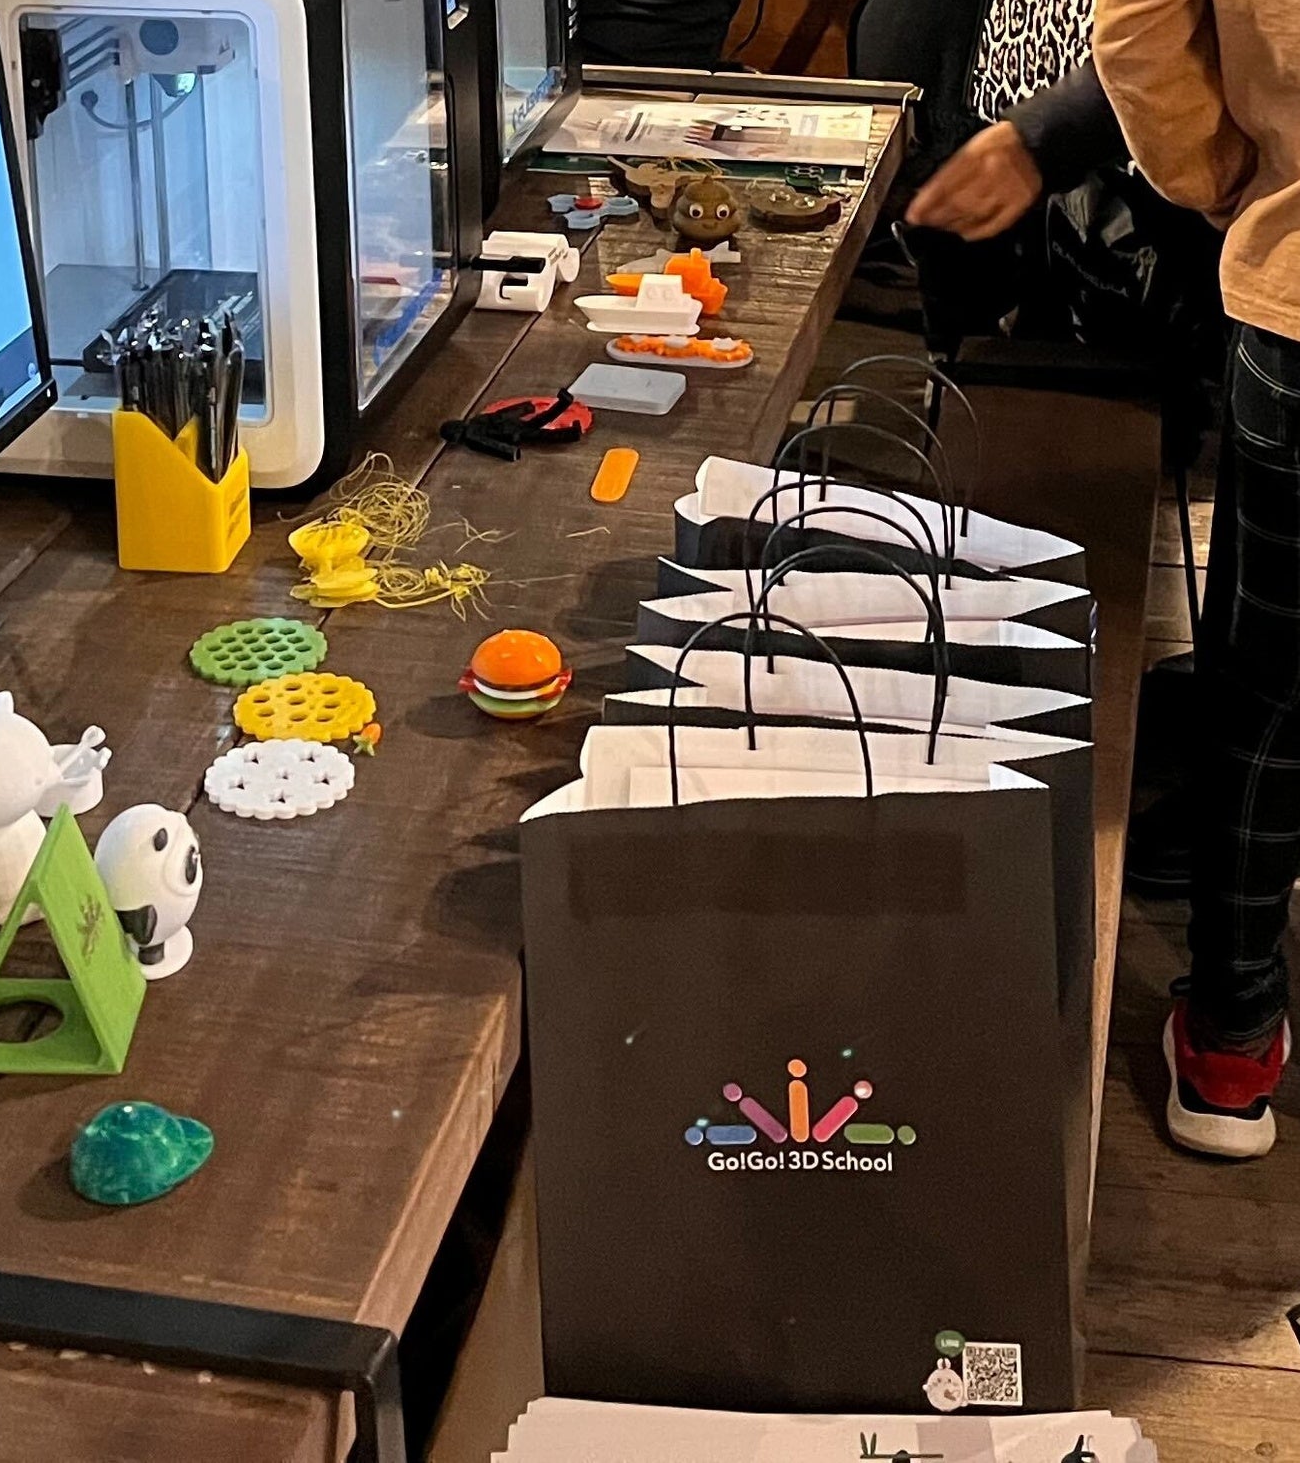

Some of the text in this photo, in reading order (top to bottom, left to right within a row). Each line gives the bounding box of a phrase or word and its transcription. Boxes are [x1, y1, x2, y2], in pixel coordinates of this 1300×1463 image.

[707, 1150, 893, 1171] Go!Go! 3D School
